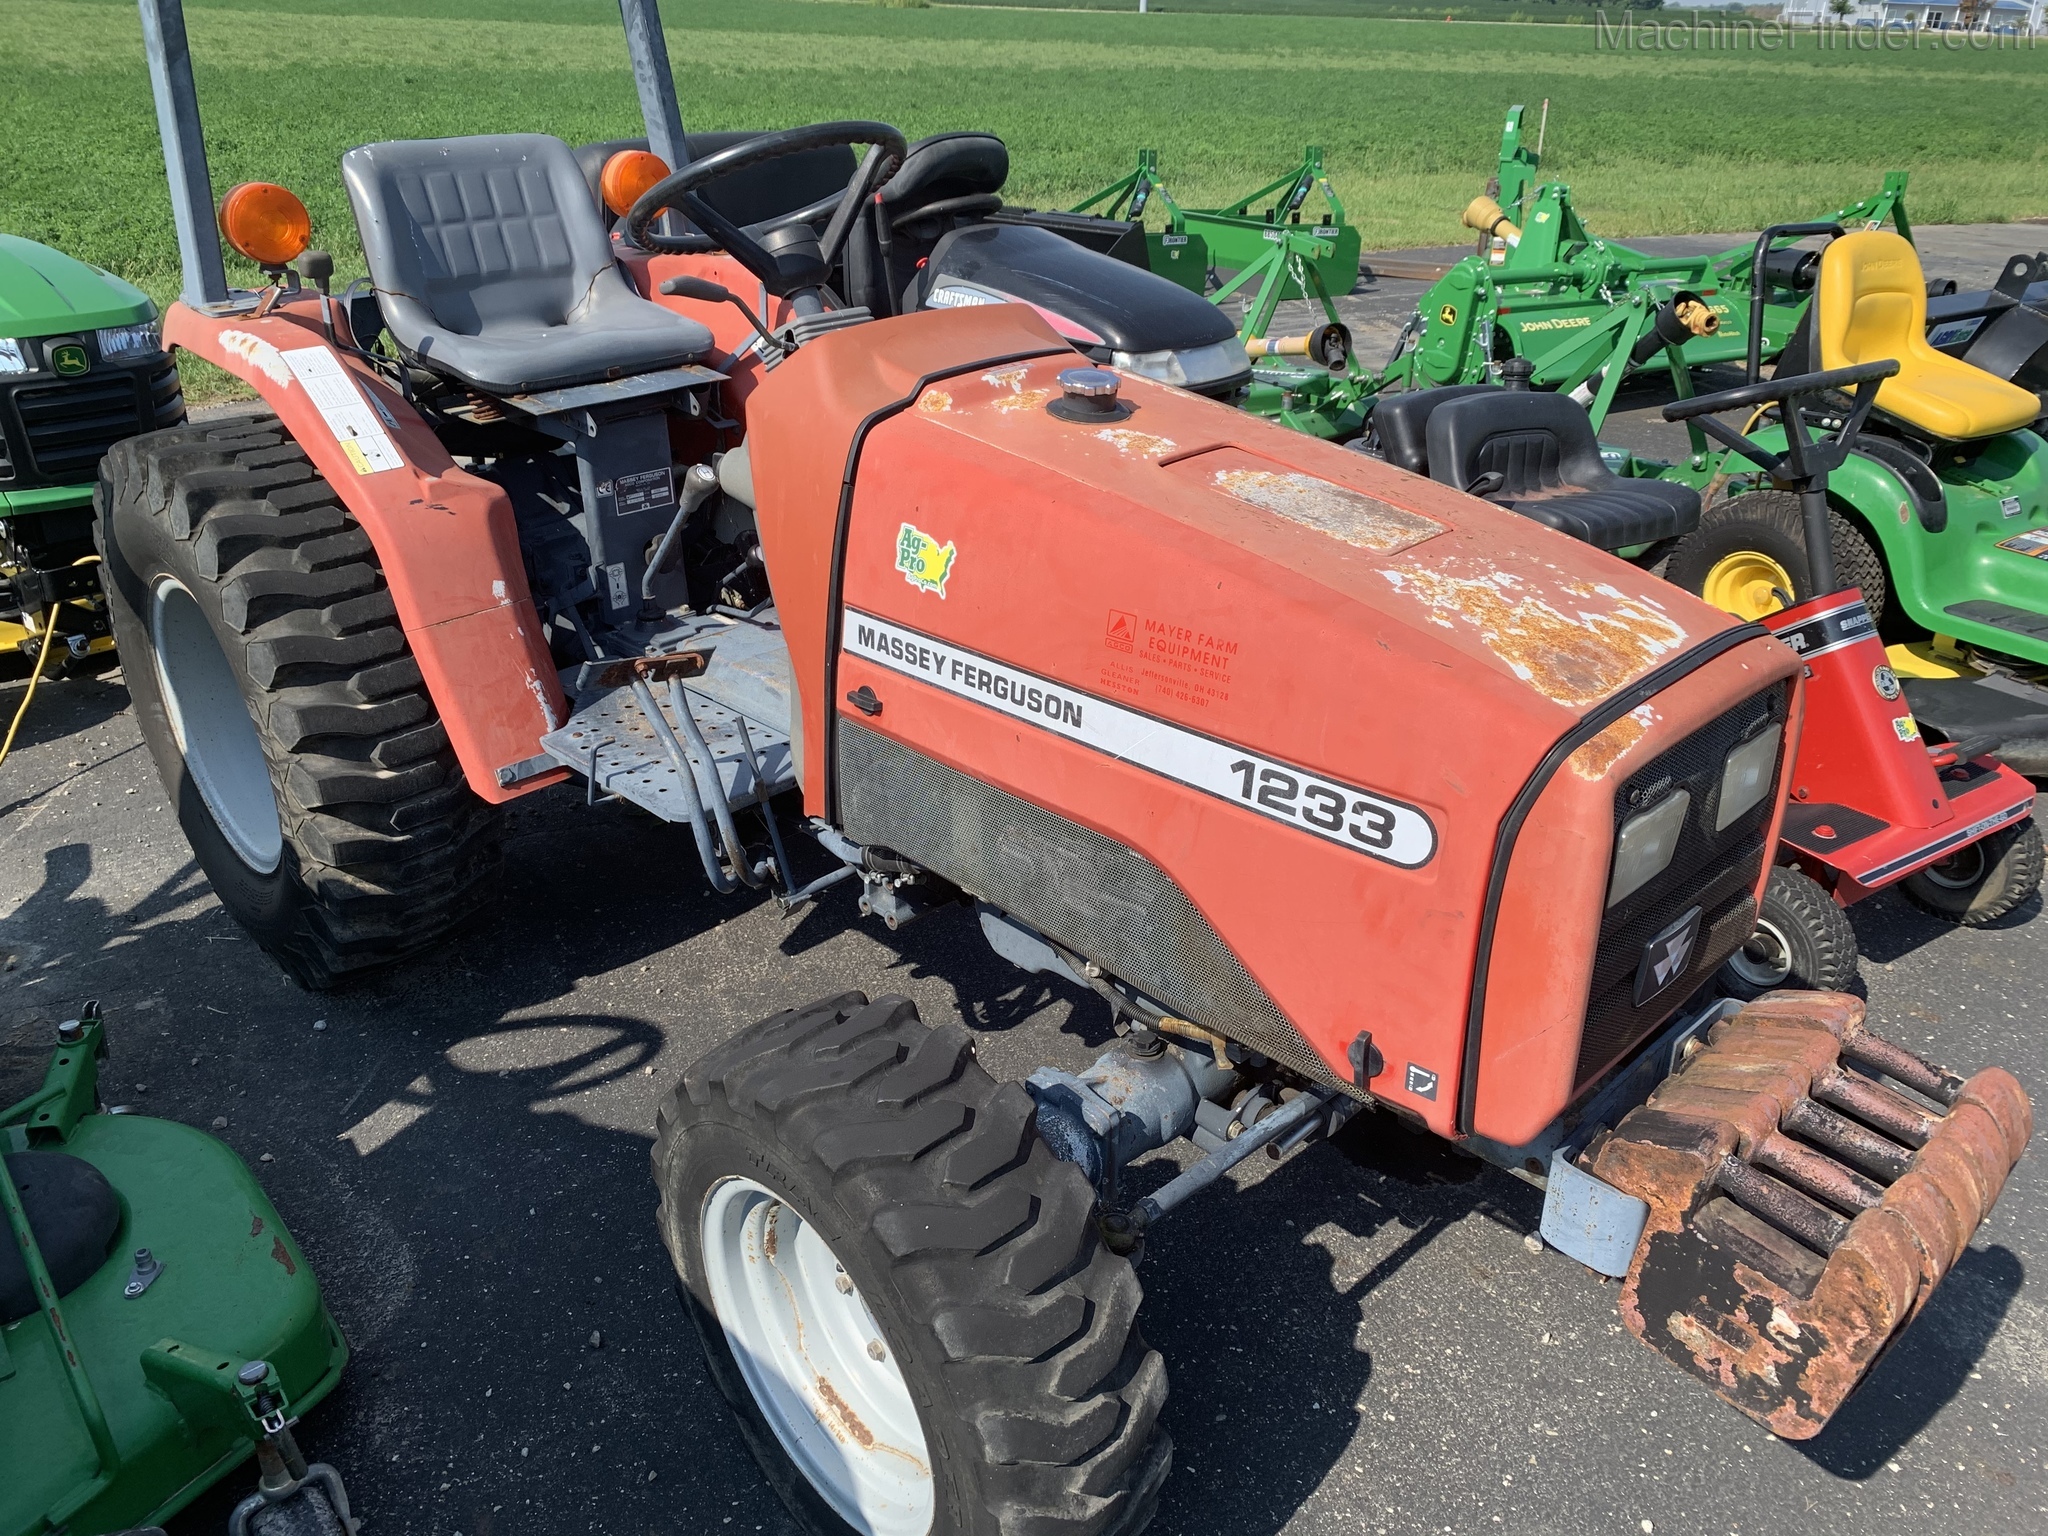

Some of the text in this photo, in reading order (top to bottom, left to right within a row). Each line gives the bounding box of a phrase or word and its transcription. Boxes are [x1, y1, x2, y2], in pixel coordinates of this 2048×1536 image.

[933, 288, 985, 307] CRAFTSMAN
[1520, 317, 1591, 332] JOHN DEERE
[900, 528, 926, 555] Ag-
[899, 548, 925, 572] Pro
[1107, 640, 1131, 651] AGCO
[1145, 619, 1238, 655] MAYER FARM
[1149, 637, 1229, 670] EQUIPMENT
[858, 624, 1083, 729] MASSEY FERGUSON
[1100, 668, 1140, 686] GLEANER
[1110, 661, 1134, 673] ALLIS
[1139, 650, 1231, 685] SALES PARTS SERVICE
[1100, 678, 1139, 696] HESSTON
[1140, 668, 1229, 701] Jeffersonville, OH 43128
[1155, 684, 1174, 698] (740)
[1230, 759, 1396, 851] 1233
